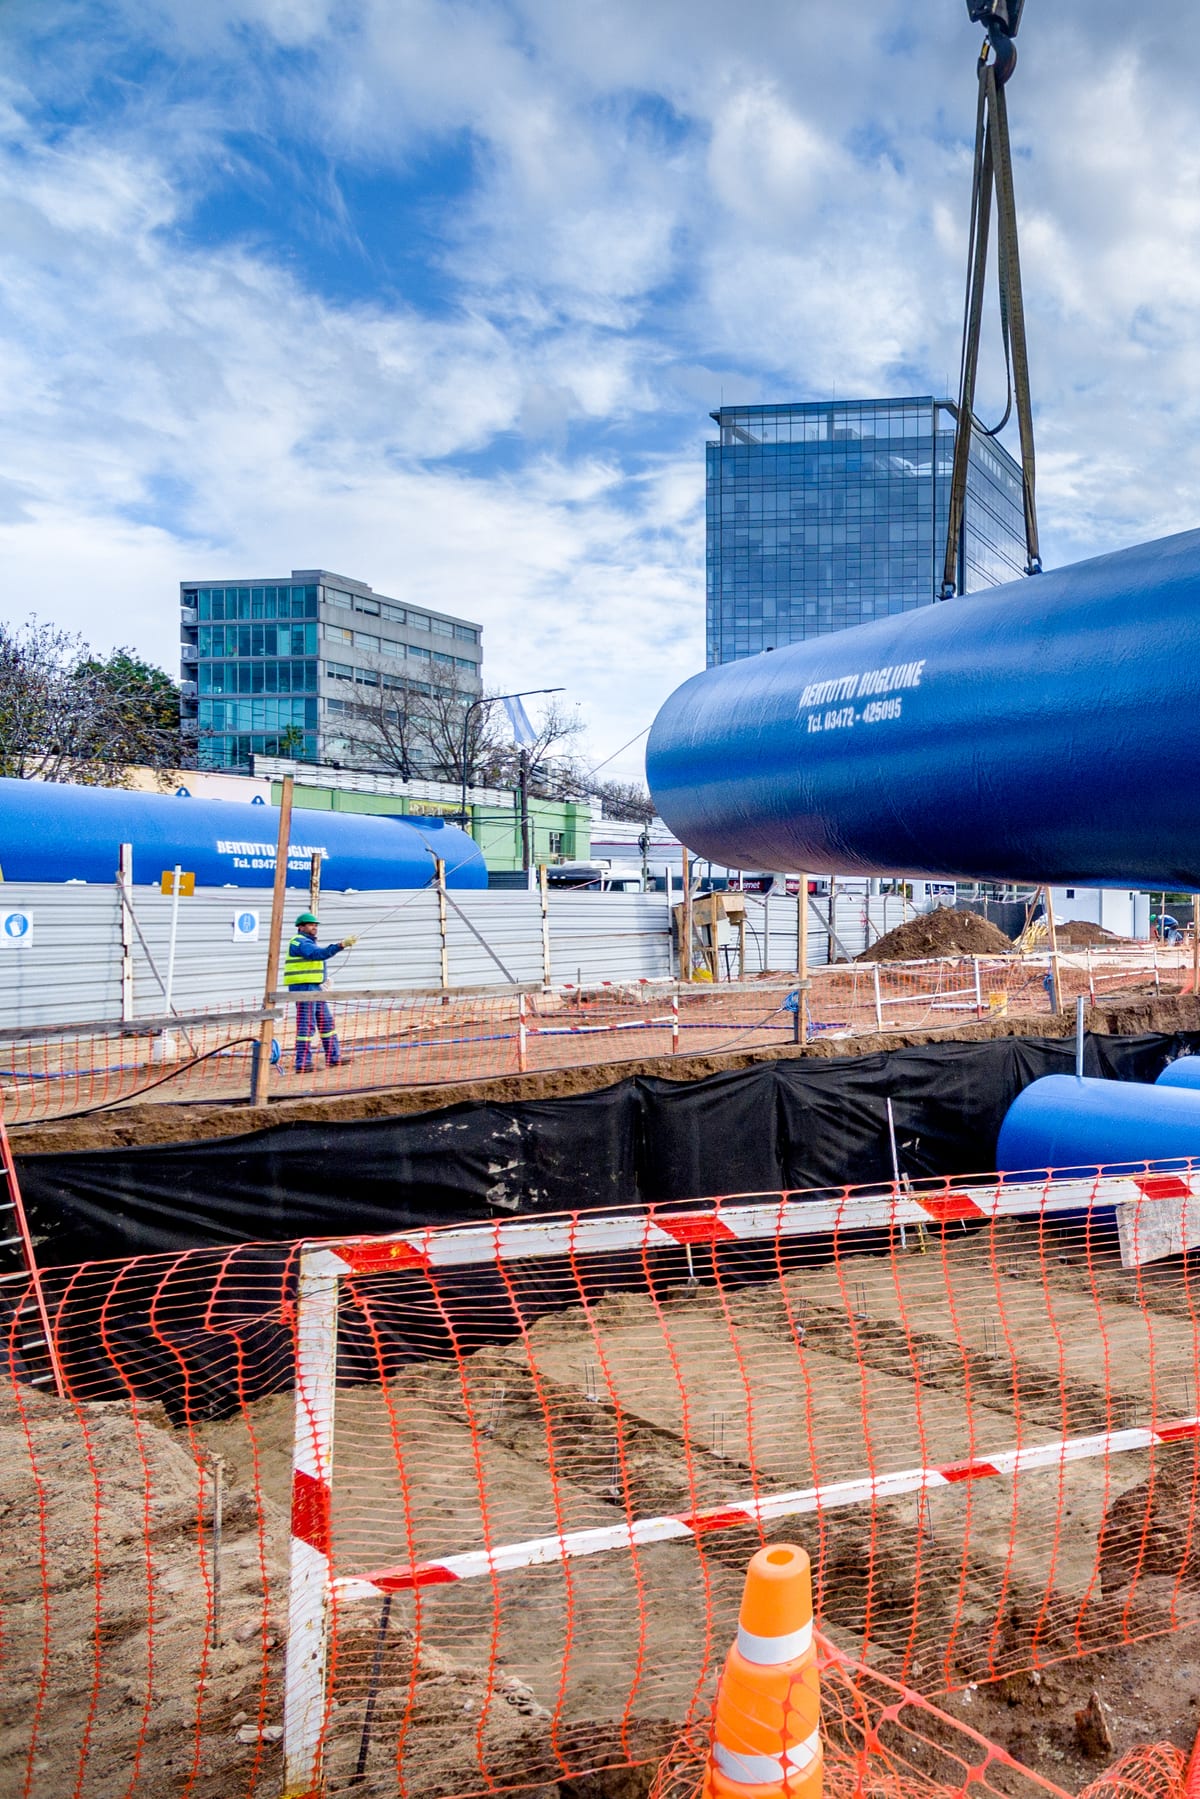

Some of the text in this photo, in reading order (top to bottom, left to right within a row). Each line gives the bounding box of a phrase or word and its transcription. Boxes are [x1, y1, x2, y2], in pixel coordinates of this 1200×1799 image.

[799, 659, 927, 708] BERTOTTO BOGLIONE
[807, 713, 823, 733] Tel.
[824, 707, 854, 730] 03472
[862, 697, 902, 723] 425095
[216, 840, 276, 857] BERTOTTO
[233, 858, 251, 868] Tel.
